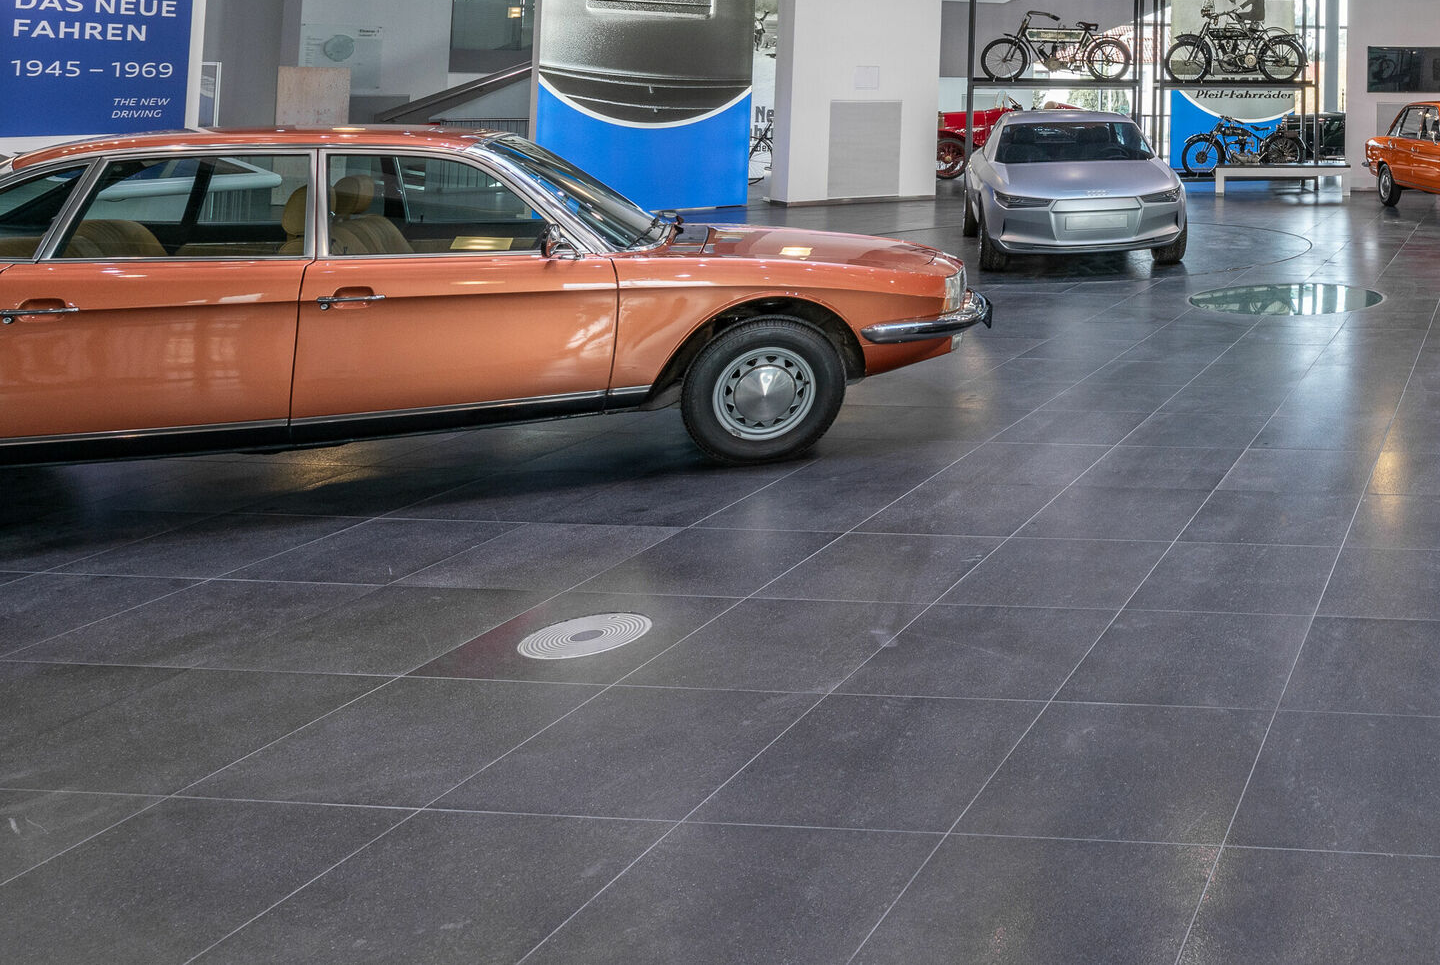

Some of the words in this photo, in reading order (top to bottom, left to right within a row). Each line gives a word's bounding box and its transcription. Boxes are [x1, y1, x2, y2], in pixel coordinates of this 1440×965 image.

[12, 19, 147, 42] FAHREN
[11, 60, 81, 77] 1945
[112, 61, 174, 78] 1969
[113, 97, 138, 107] THE
[140, 97, 171, 107] NEW
[111, 109, 163, 119] DRIVING
